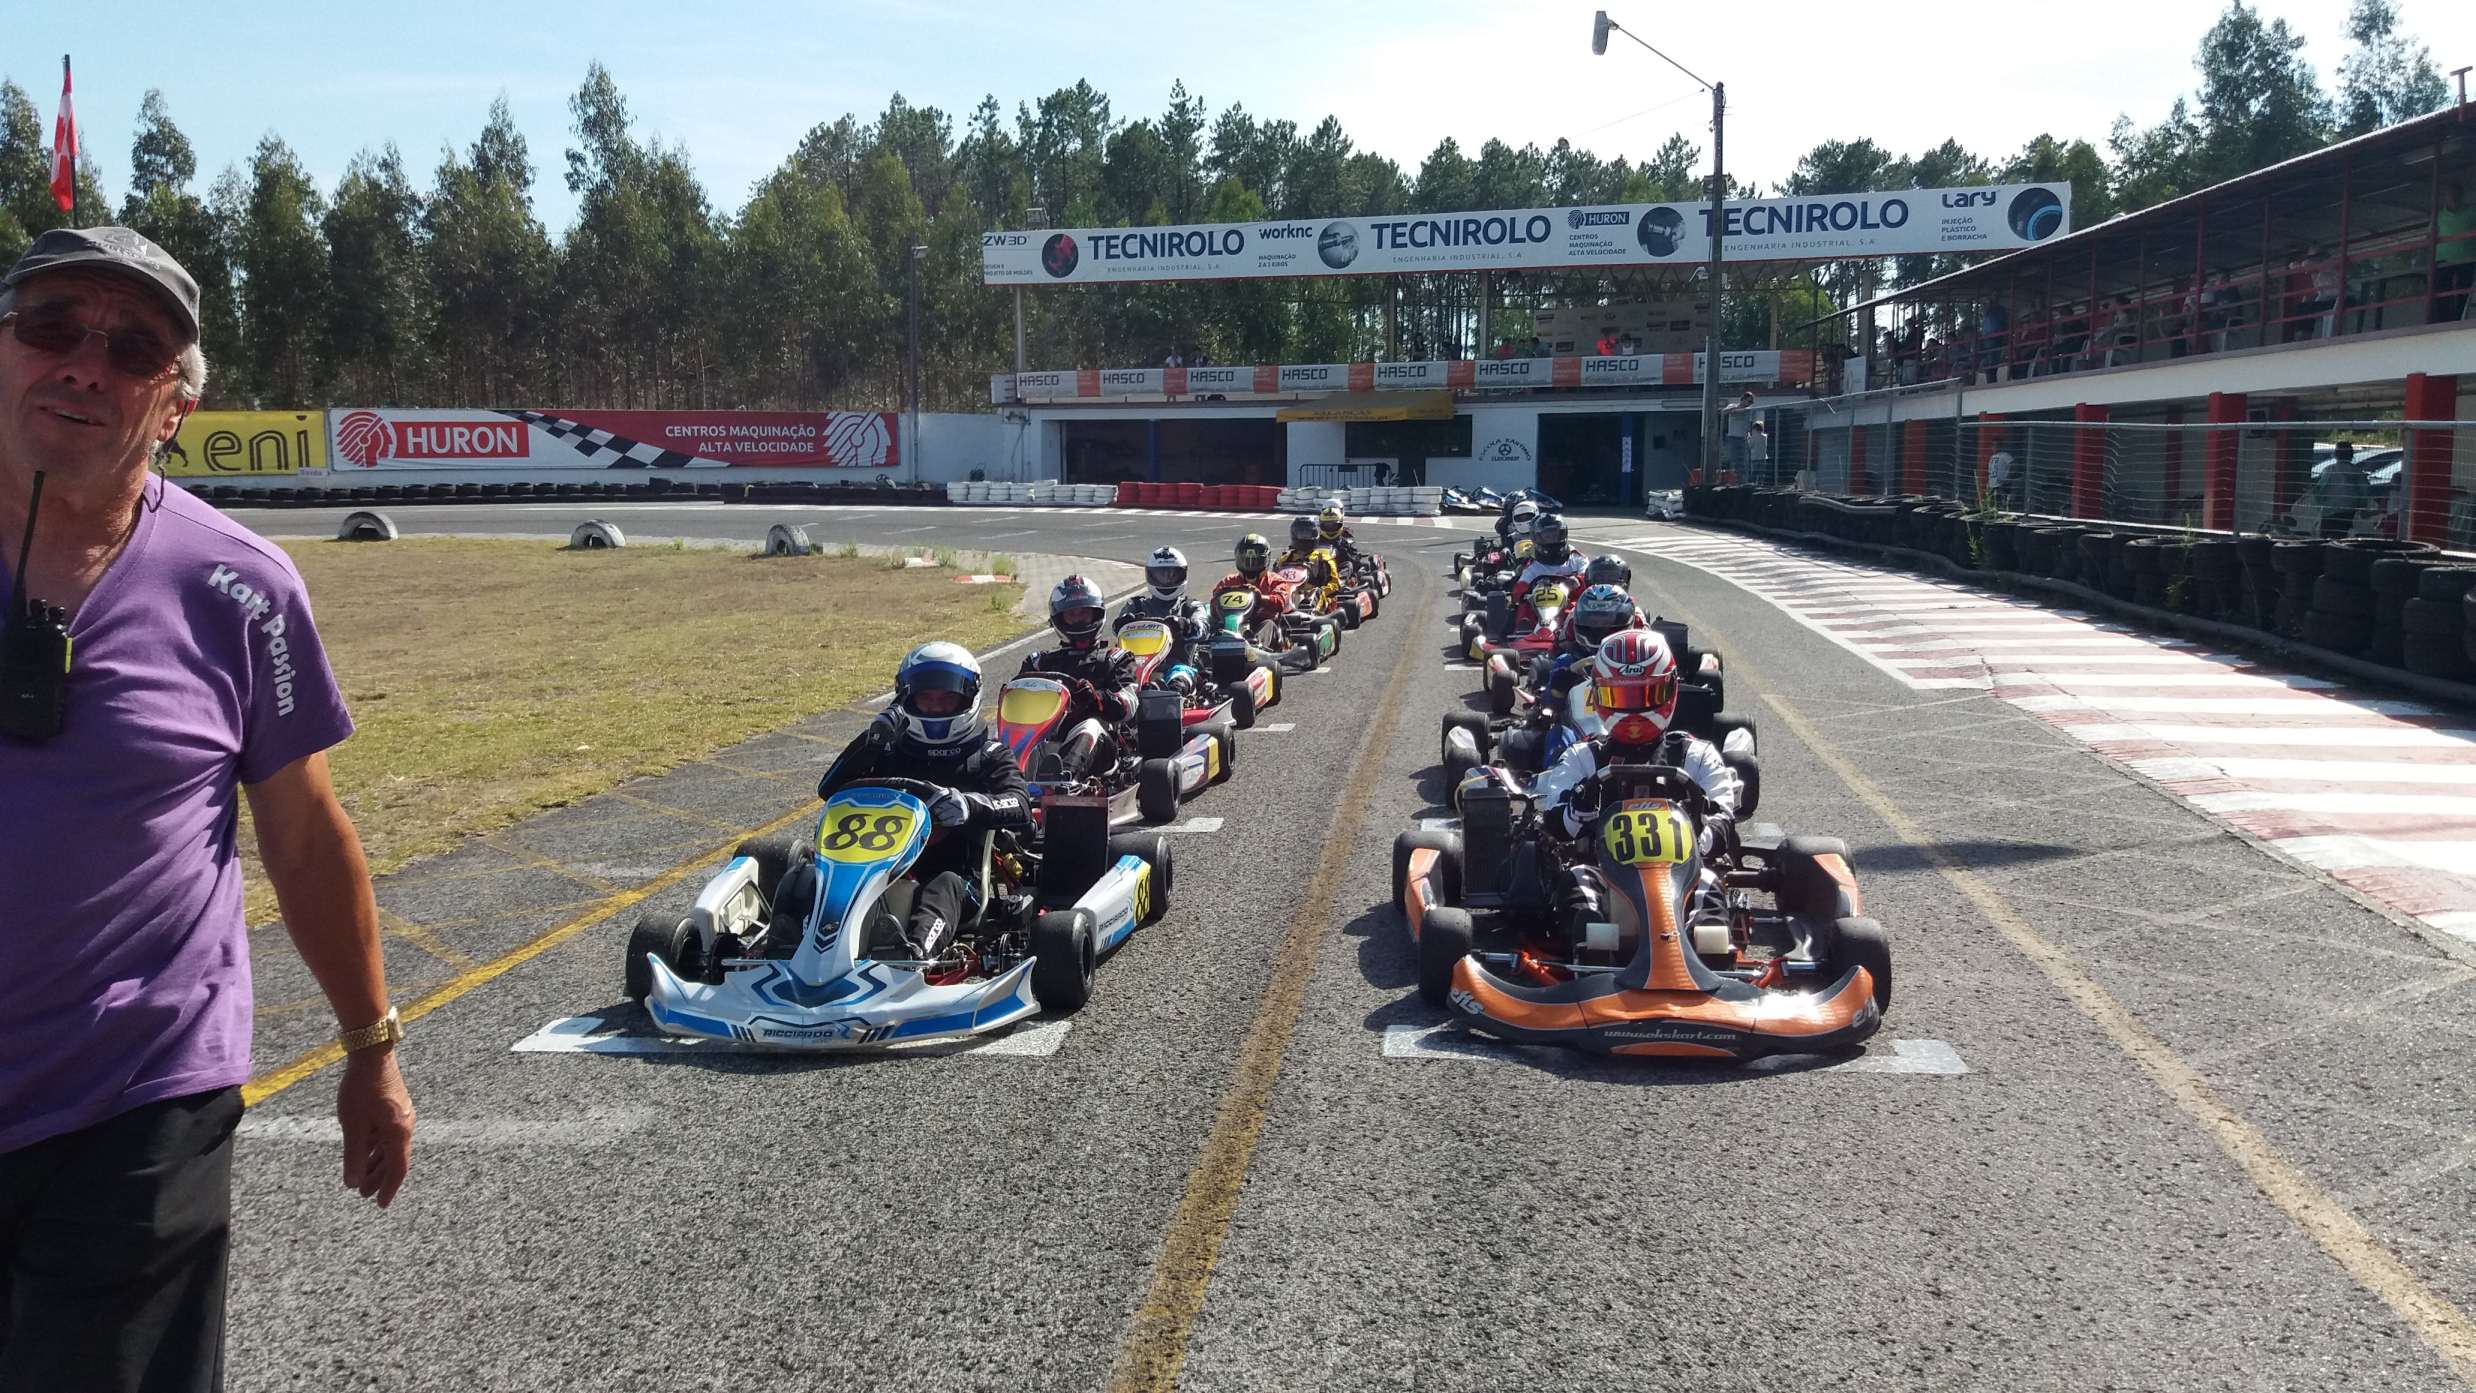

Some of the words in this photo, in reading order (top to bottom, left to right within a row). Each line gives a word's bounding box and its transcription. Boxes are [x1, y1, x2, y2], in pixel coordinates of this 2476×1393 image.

[1942, 191, 1997, 209] Lary
[1588, 213, 1626, 225] HURON
[1698, 198, 1909, 238] TECNIROLO
[1941, 217, 1974, 226] INJEÇÃO
[1370, 215, 1552, 250] TECNIROLO
[1569, 233, 1599, 241] CENTROS
[1947, 233, 1988, 241] BORRACHA
[983, 235, 1028, 247] ZW3D
[1087, 229, 1246, 261] TECNIROLO
[1568, 240, 1613, 249] MAQUINAÇÃO
[1724, 242, 1787, 252] ENGENHARIA
[1586, 248, 1627, 256] VELOCIDADE
[1393, 255, 1447, 264] ENGENHARIA
[1585, 359, 1640, 373] HASCO
[1698, 354, 1755, 369] HSCO
[1282, 368, 1329, 381] HASCO
[1377, 366, 1427, 379] HASCO
[1479, 362, 1530, 376] HASCO
[1019, 375, 1060, 386] HASCO
[1103, 373, 1146, 385] HASCO
[1190, 371, 1235, 383] HASCO
[665, 425, 727, 438] CENTROS
[729, 423, 817, 440] MAQUINAÇÃO
[204, 415, 310, 471] eni
[406, 427, 519, 454] HURON
[699, 442, 733, 453] ALTA
[735, 441, 815, 453] VELOCIDADE
[1223, 595, 1244, 605] 74
[1536, 588, 1558, 602] 25
[208, 564, 272, 620] Kart
[261, 614, 295, 716] Passion
[928, 747, 961, 757] sparco
[823, 813, 911, 851] 88
[1612, 813, 1684, 862] 331
